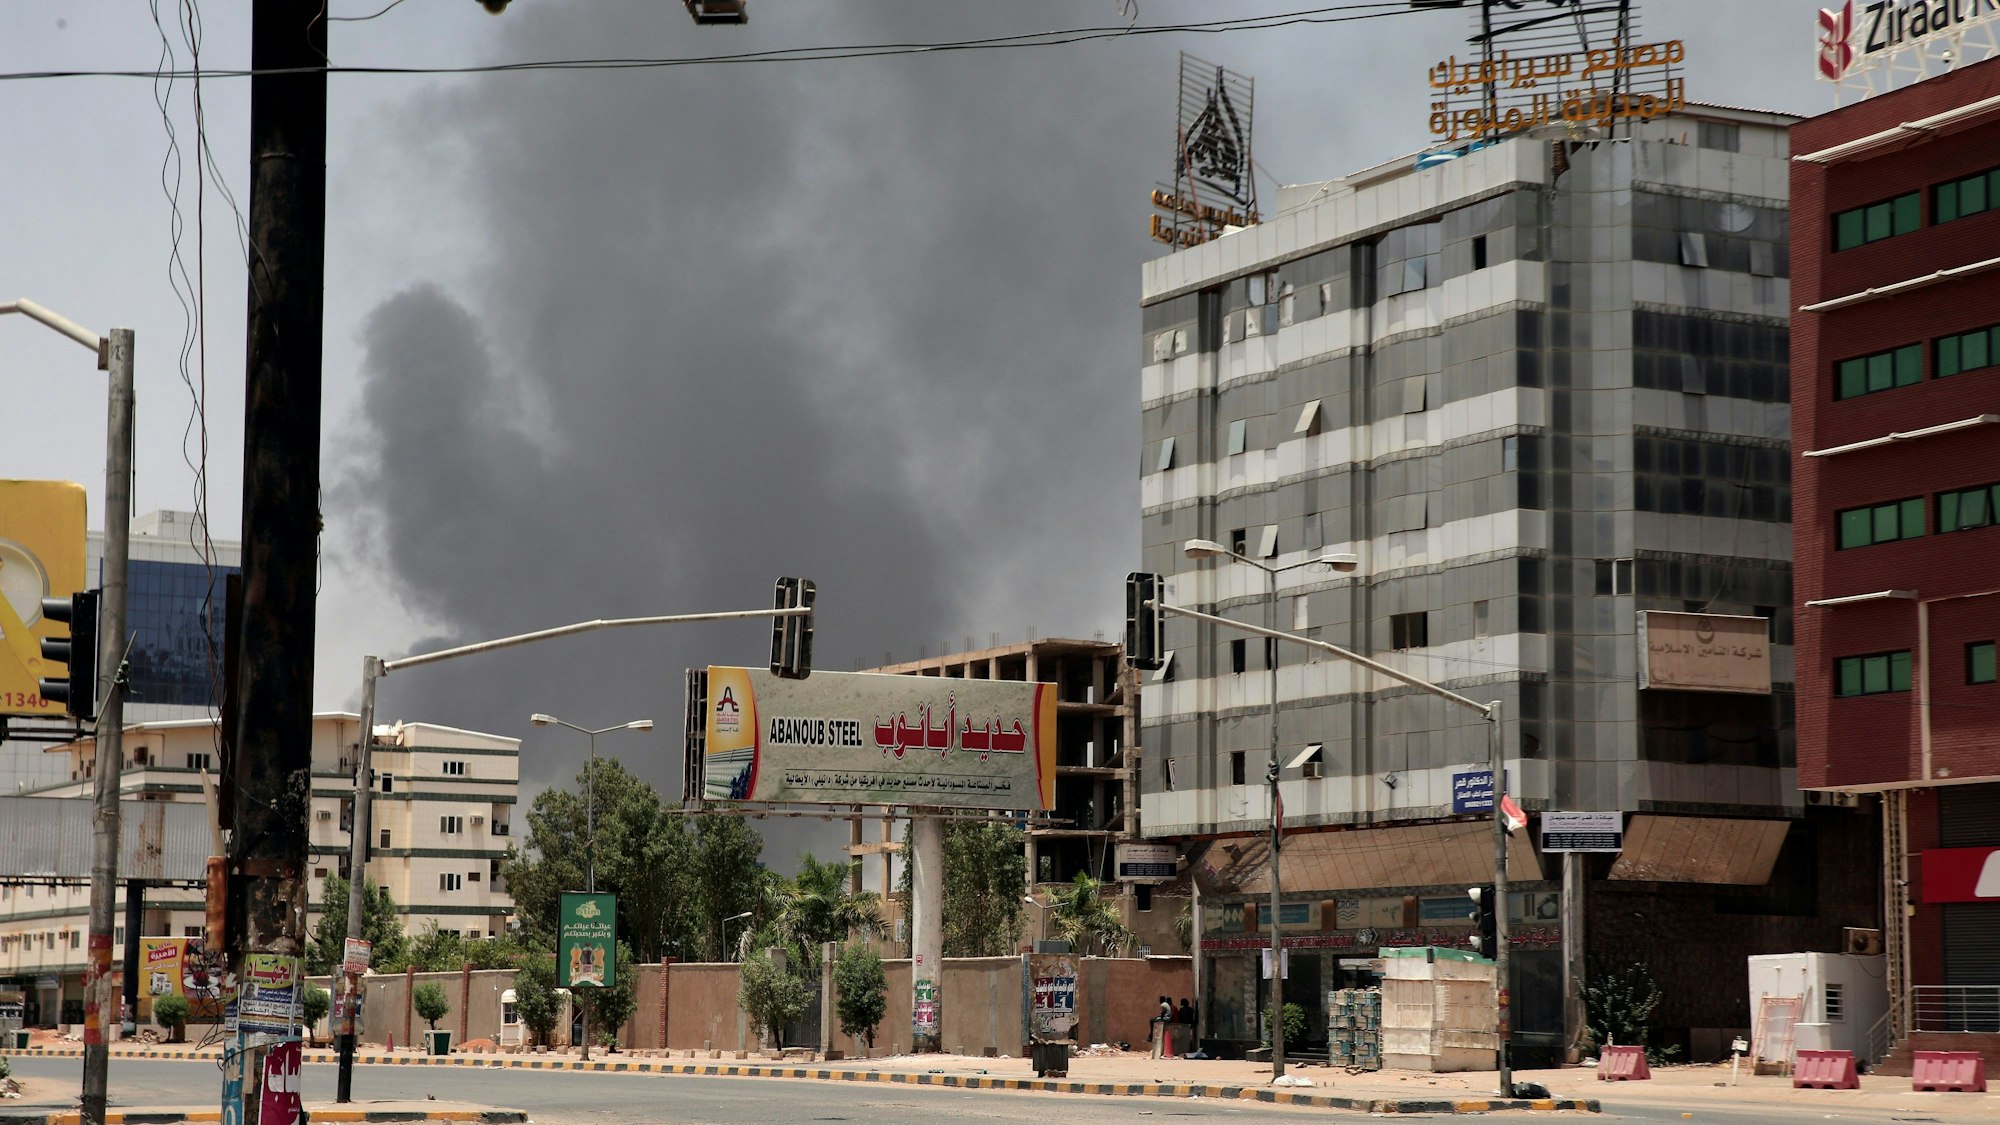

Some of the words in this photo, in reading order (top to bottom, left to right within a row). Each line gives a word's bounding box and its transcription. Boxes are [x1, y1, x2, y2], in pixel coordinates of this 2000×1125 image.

[1866, 0, 1964, 53] Ziraat
[1429, 49, 1572, 96] سيراميك
[1582, 37, 1685, 82] مصنع
[1563, 77, 1685, 128] المدينة
[1429, 93, 1549, 142] المنورة
[1732, 646, 1763, 661] شركة
[5, 691, 49, 708] 1346
[769, 718, 825, 745] ABANOUB
[828, 720, 863, 746] STEEL
[873, 689, 956, 760] أبانوب
[961, 712, 1028, 763] حديد
[834, 773, 849, 786] شركة
[886, 778, 901, 788] حديد
[902, 777, 917, 789] مصنع
[937, 777, 965, 790] السودانية
[247, 960, 293, 984] الجهاد
